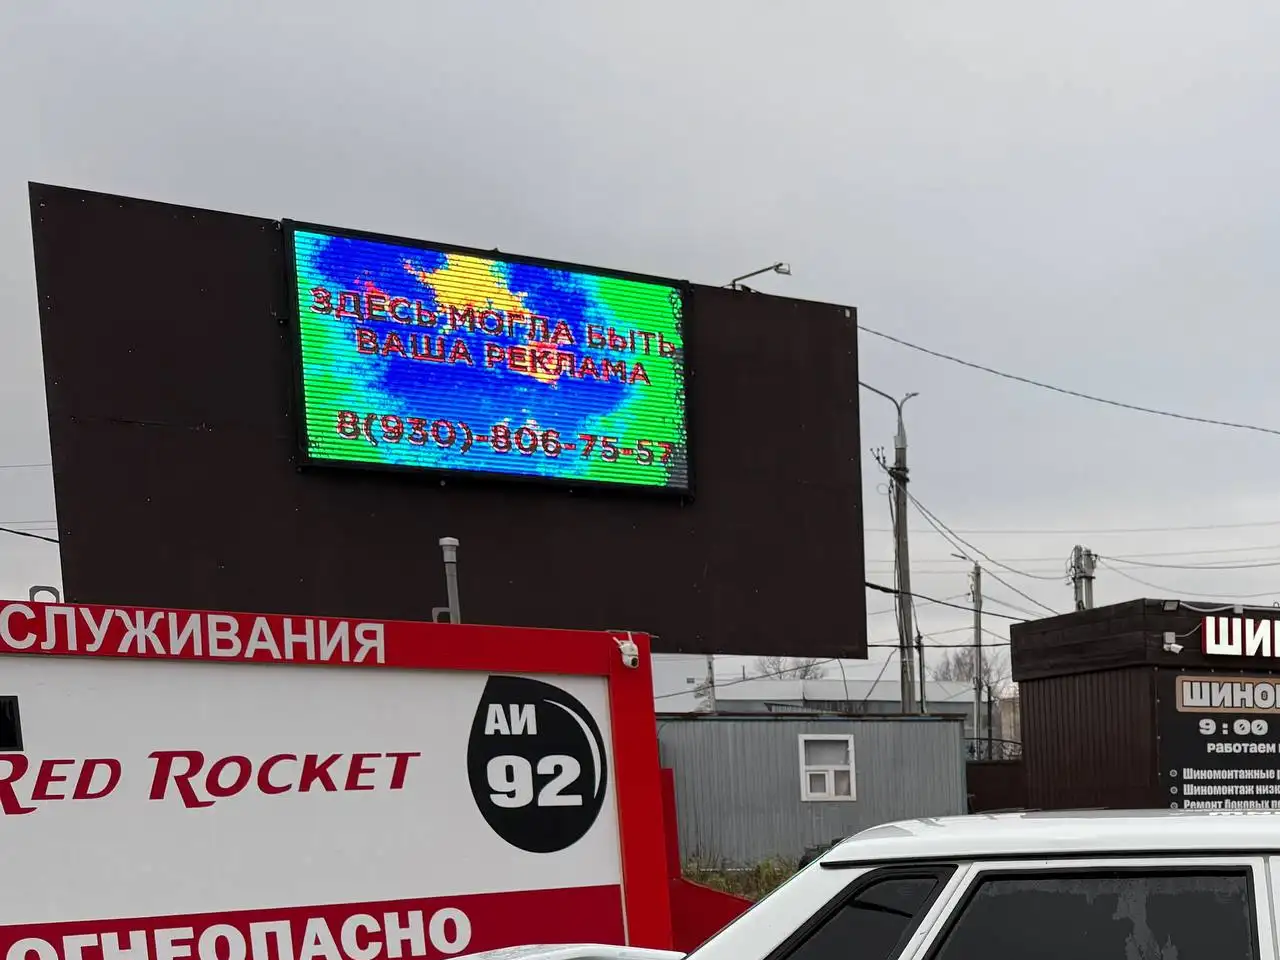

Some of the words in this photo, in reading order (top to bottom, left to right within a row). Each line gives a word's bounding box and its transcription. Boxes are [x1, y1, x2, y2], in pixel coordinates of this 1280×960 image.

[308, 286, 437, 327] ЗДЕСЬ
[449, 305, 575, 345] МОГЛА
[586, 324, 677, 357] БЫТЬ
[355, 327, 474, 365] ВАША
[485, 341, 652, 386] РЕКЛАМА
[335, 410, 674, 466] 8(930)-806-75-57
[484, 703, 537, 736] АИ
[487, 755, 583, 808] 92
[1183, 768, 1275, 780] Шиномонтажные
[1183, 784, 1253, 795] Шиномонтаж
